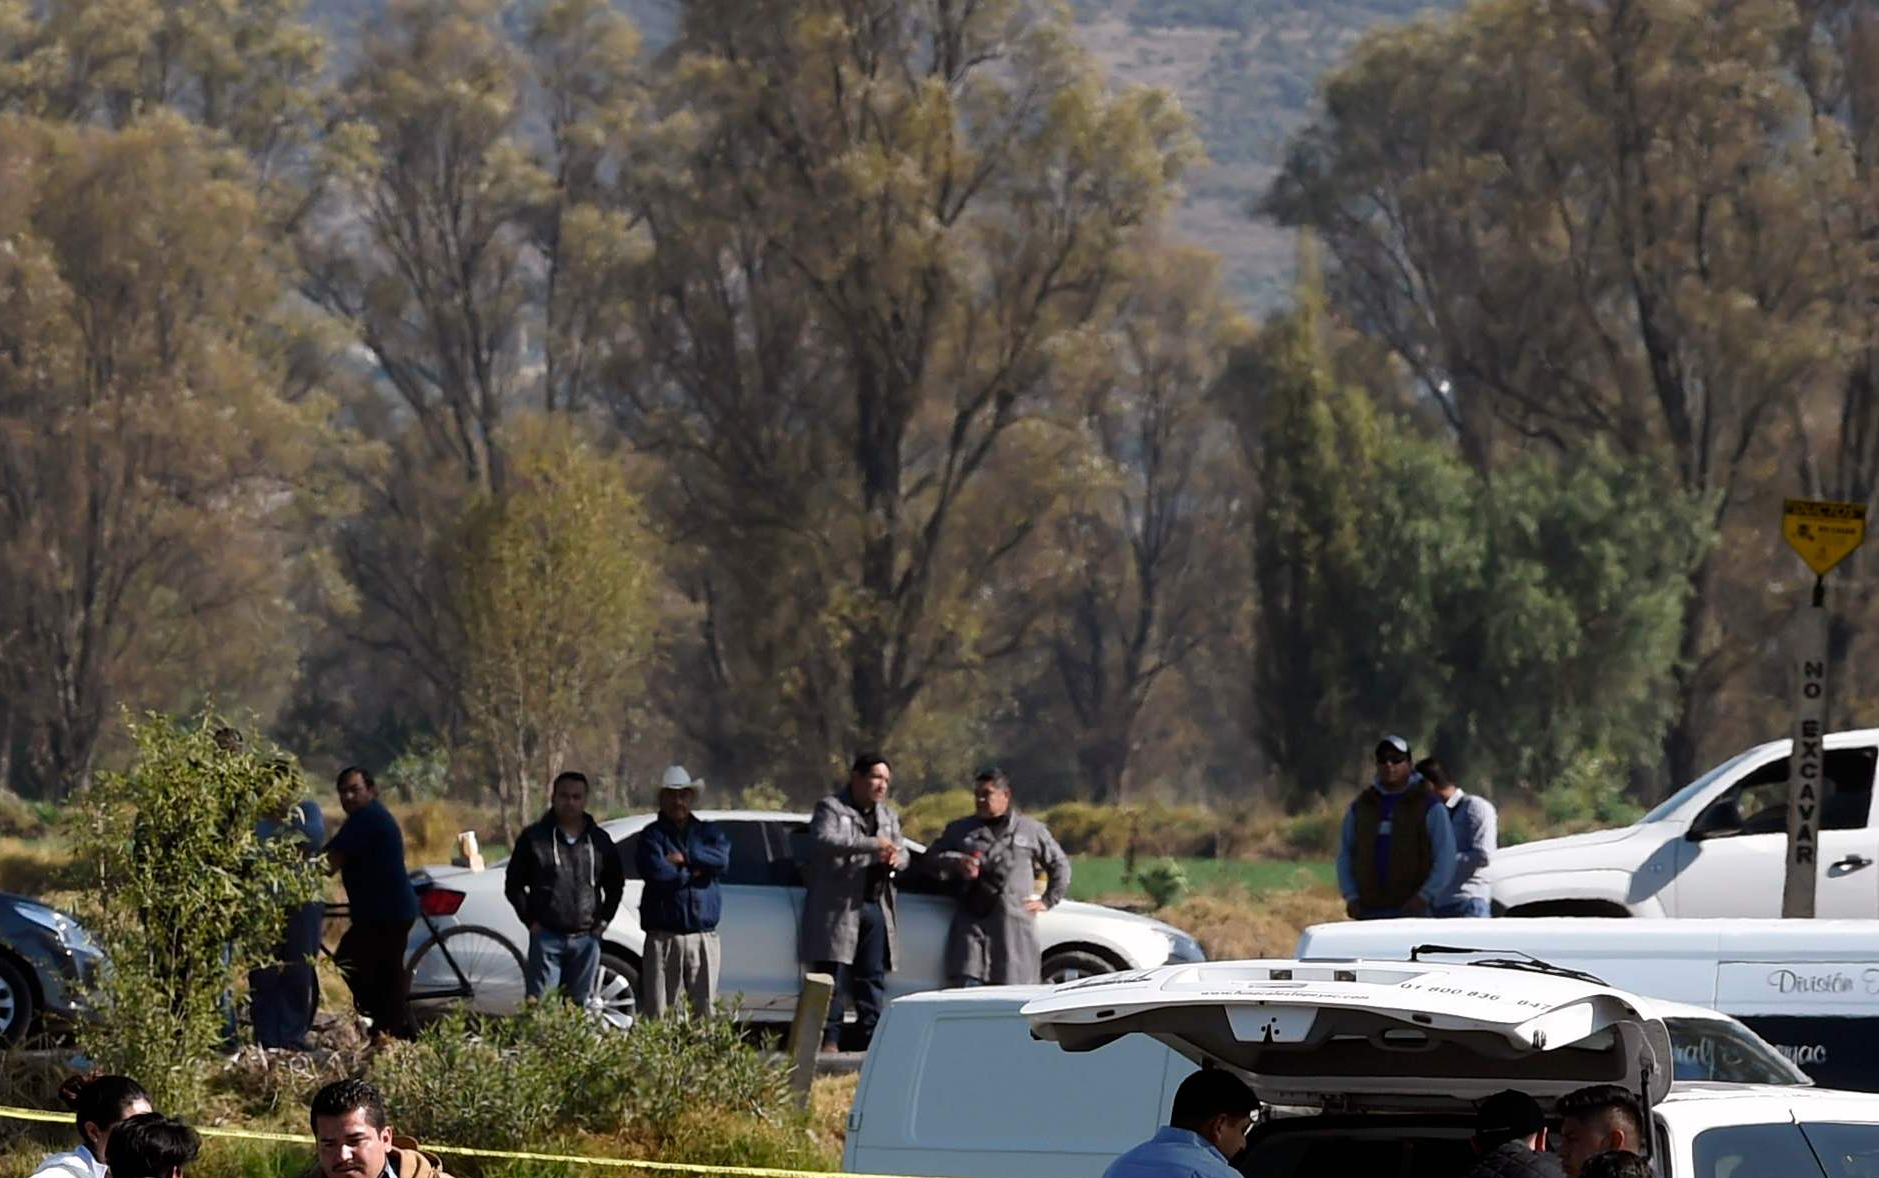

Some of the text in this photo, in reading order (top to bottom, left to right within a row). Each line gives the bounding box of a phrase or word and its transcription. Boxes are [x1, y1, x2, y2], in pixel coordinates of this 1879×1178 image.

[1804, 661, 1823, 698] NO
[1796, 721, 1819, 865] EXCAVAR
[1768, 969, 1853, 993] División
